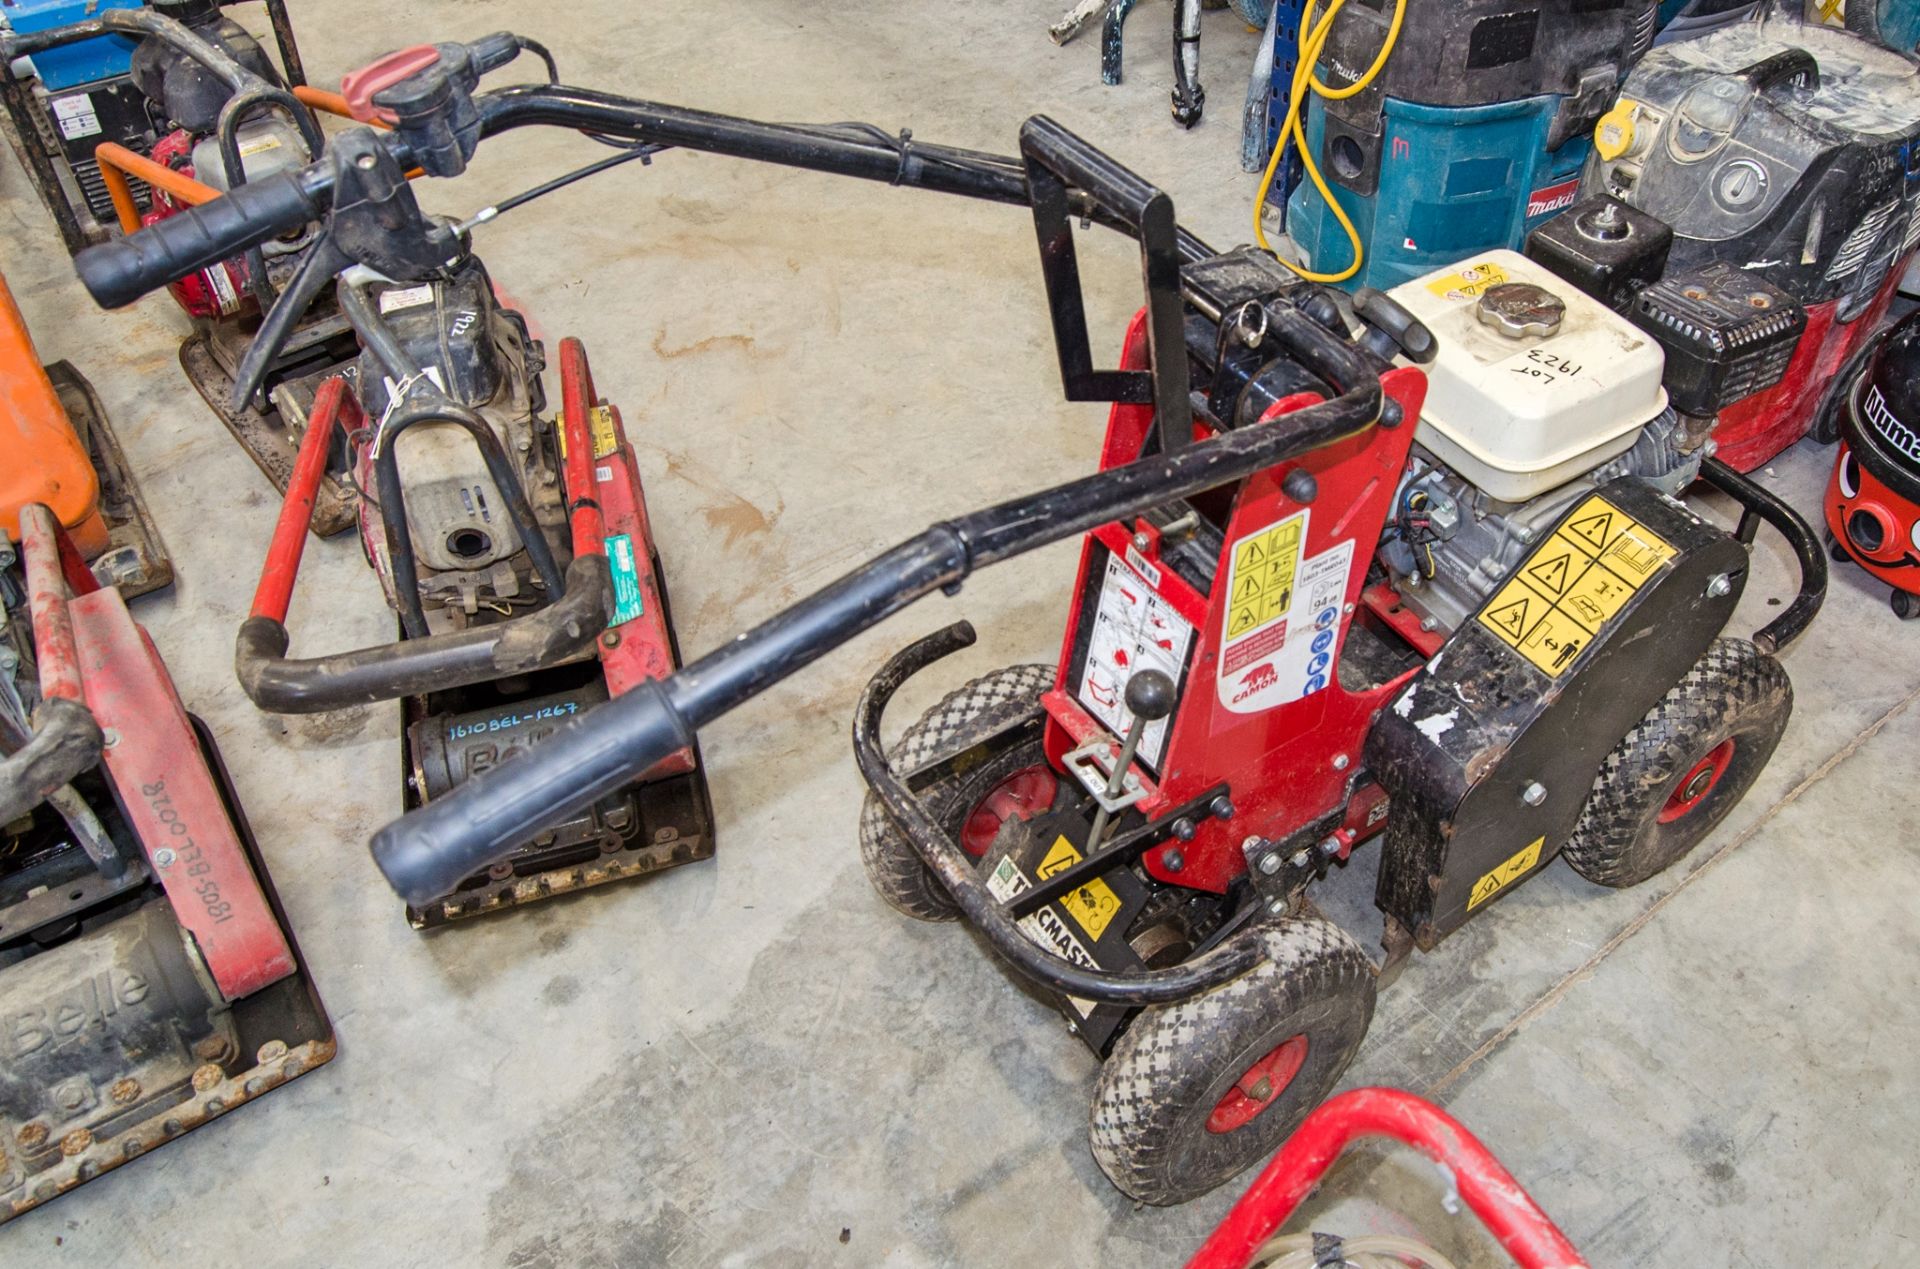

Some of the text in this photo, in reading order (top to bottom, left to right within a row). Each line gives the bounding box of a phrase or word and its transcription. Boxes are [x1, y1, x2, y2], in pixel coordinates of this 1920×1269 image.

[451, 310, 477, 337] 1922
[1510, 366, 1555, 385] LOT
[1527, 349, 1582, 376] 1923
[1232, 673, 1279, 705] CAMON
[4, 969, 150, 1060] Belle
